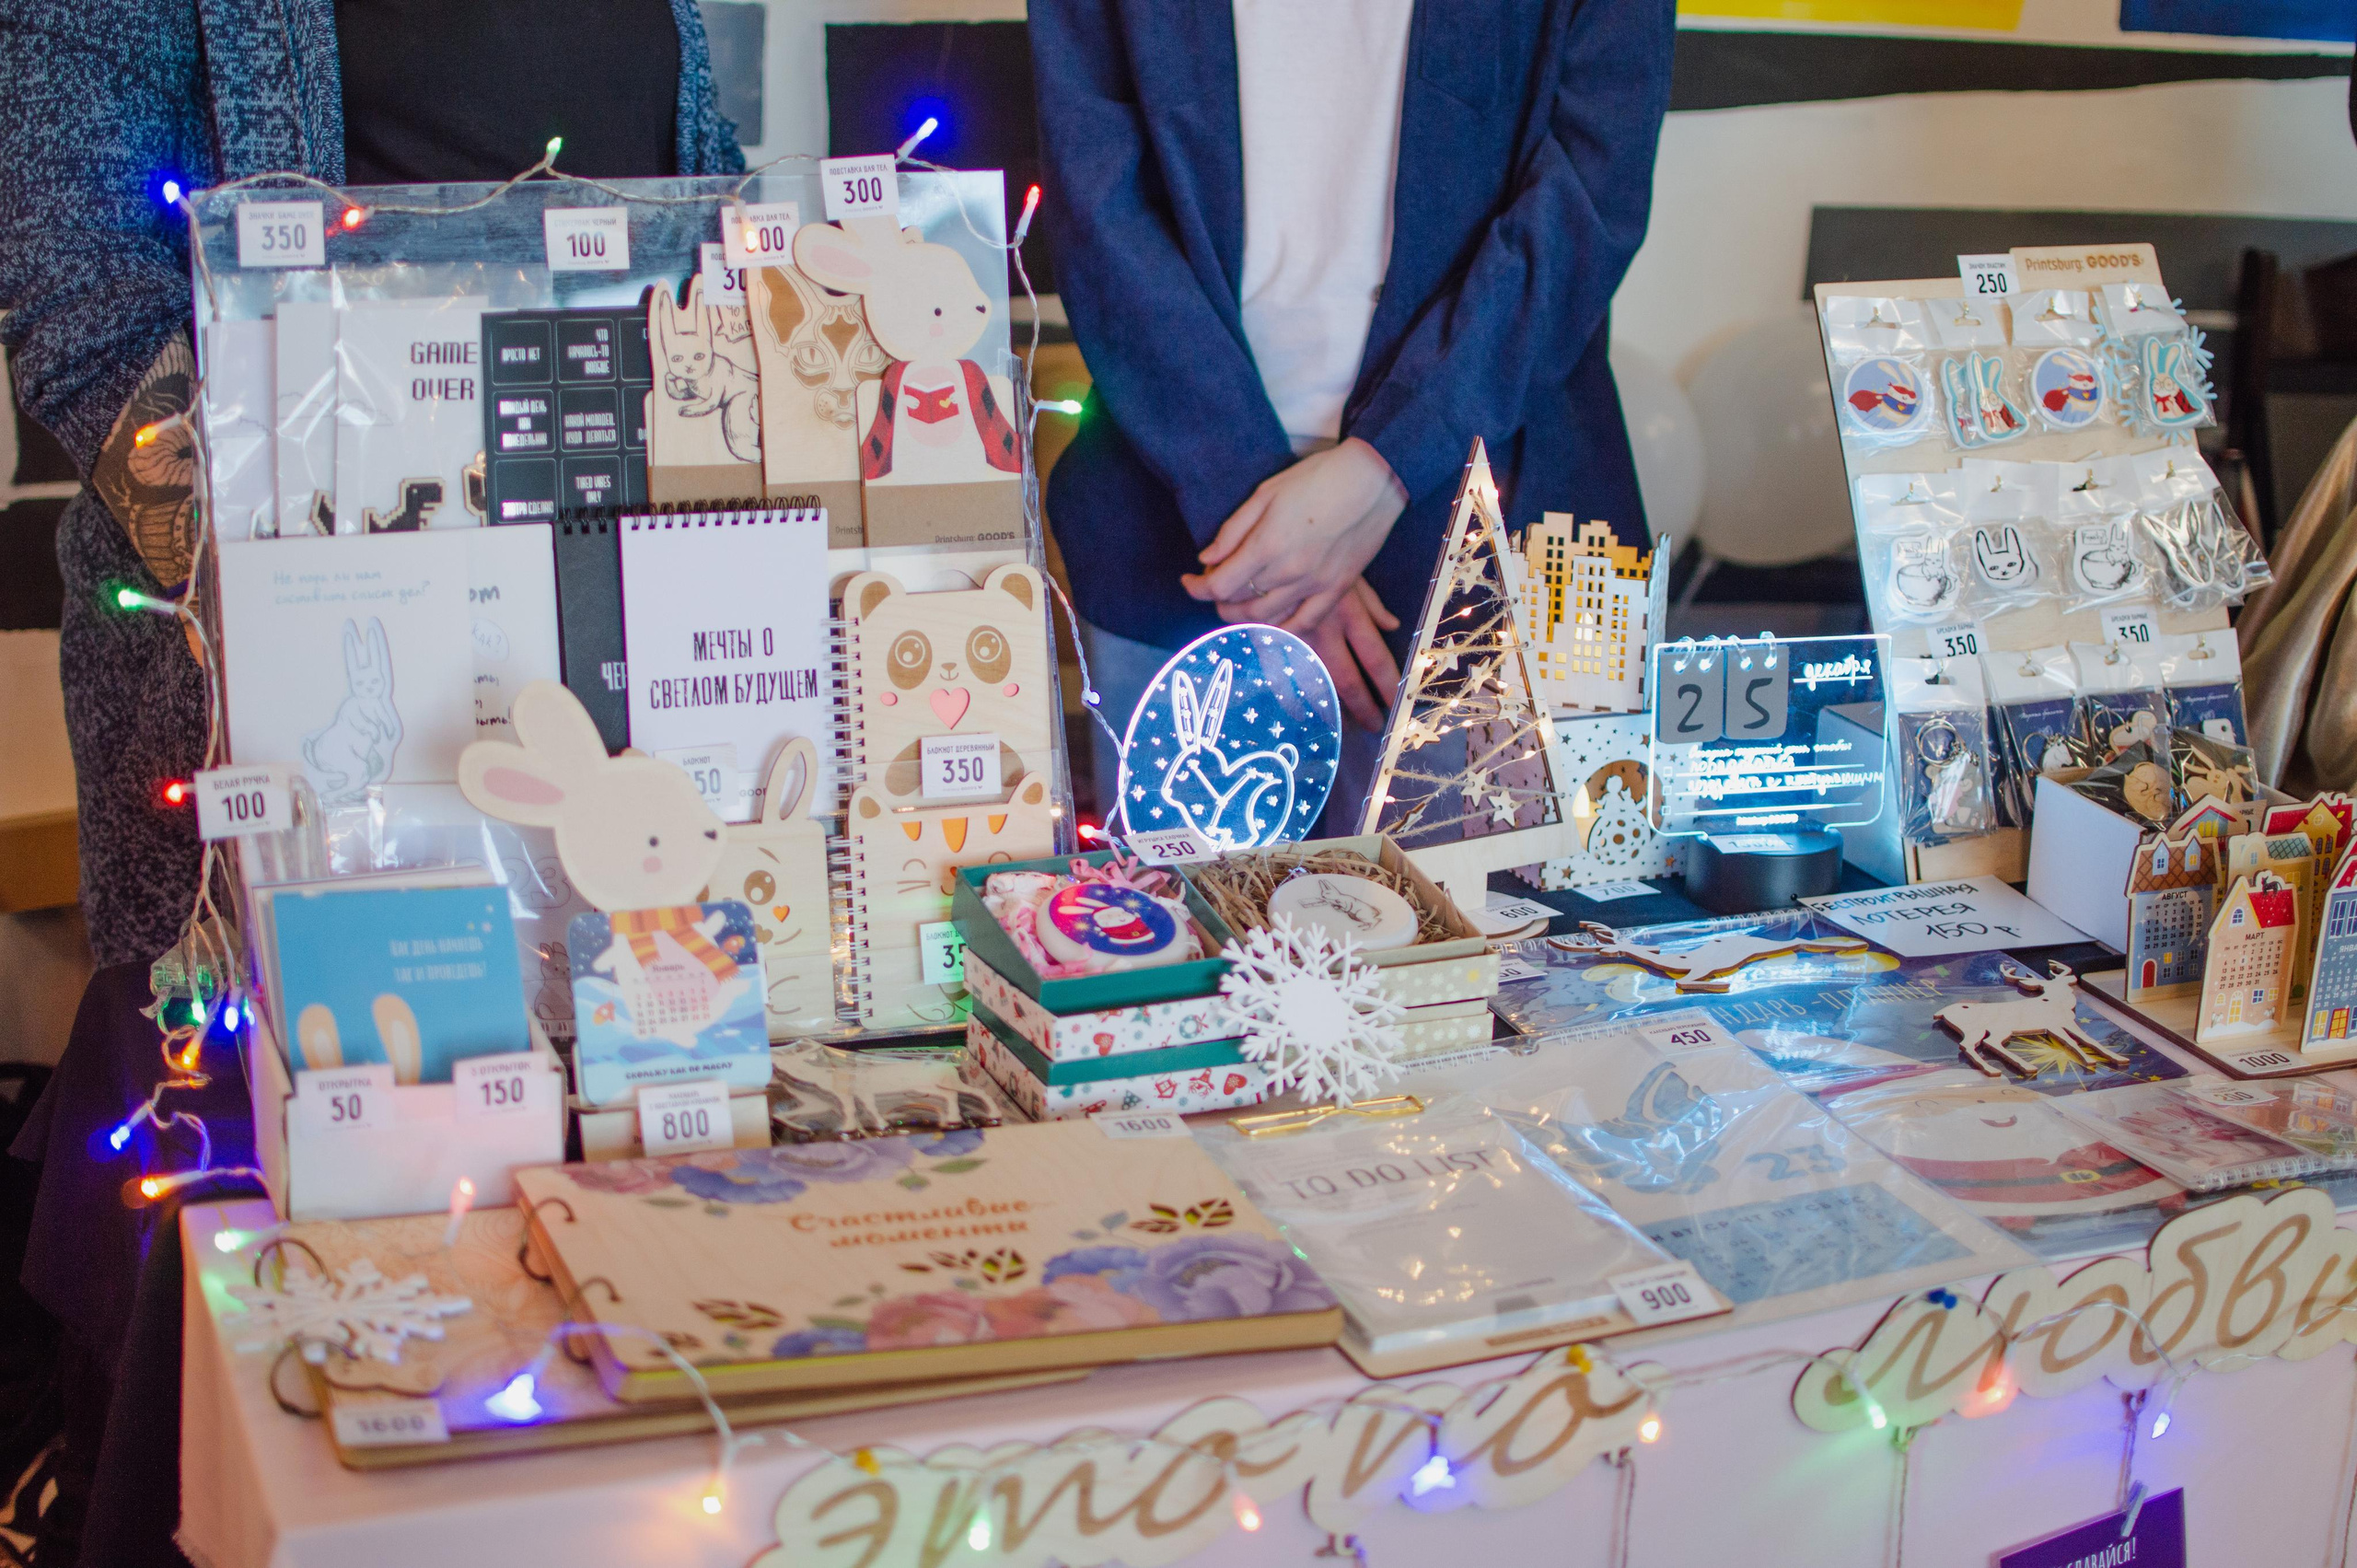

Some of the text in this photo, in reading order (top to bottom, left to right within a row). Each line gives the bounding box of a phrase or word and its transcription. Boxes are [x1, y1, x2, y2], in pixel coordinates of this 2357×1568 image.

[830, 166, 862, 175] ПОДСТАВКА
[842, 177, 883, 204] 300
[249, 212, 274, 220] ЗНАЧКИ
[592, 217, 617, 226] ЧЕРНЫЙ
[731, 214, 765, 224] ПОДАВКА
[766, 214, 778, 222] ДЛЯ
[261, 224, 307, 250] 350
[566, 231, 606, 258] 100
[745, 226, 784, 253] 00
[2026, 257, 2084, 273] Printsburg:
[1977, 273, 2007, 294] 250
[596, 329, 609, 342] ЧТО
[411, 342, 478, 365] GAME
[502, 347, 540, 362] ПРОСТО НЕТ
[412, 377, 474, 401] OVER
[530, 399, 547, 413] ДЕНЬ
[517, 417, 531, 431] КАК
[564, 412, 585, 427] КАКОЙ
[565, 428, 616, 444] КУДА ДЕВАТЬСЯ
[575, 475, 611, 490] TIRED VIBES
[586, 491, 601, 504] ONLY
[528, 500, 553, 515] СДЕЛАЮ
[2119, 623, 2149, 643] 350
[692, 627, 773, 662] МЕЧТЫ О
[1945, 633, 1978, 657] 350
[1804, 654, 1872, 691] декабря
[650, 668, 819, 710] СВЕТЛОМ БУДУЩЕМ
[1677, 683, 1703, 733] 2
[927, 742, 995, 754] БЛОКНОТ ДЕРЕВЯННЫЙ
[683, 756, 711, 766] БЛОКНОТ
[942, 757, 983, 784] 350
[214, 774, 271, 791] БЕЛАЯ РУЧКА
[222, 791, 265, 822] 100
[1152, 841, 1196, 858] 250
[1597, 885, 1638, 896] 700
[1811, 883, 1980, 912] БЕСПРОИГРЫШНАЯ
[2162, 891, 2188, 901] АВГУСТ
[1500, 906, 1538, 919] 600
[1850, 901, 1977, 926] ЛОТЕРЕЯ
[926, 931, 953, 940] БЛОКНОТ
[1926, 921, 1989, 940] 150
[2246, 932, 2265, 940] МАРТ
[1671, 1028, 1712, 1045] 450
[2238, 1052, 2291, 1067] 1000
[480, 1062, 531, 1076] ОТКРЫТОК
[625, 1068, 668, 1079] СКОЛЬЖУ
[702, 1062, 733, 1071] МАСЛУ
[319, 1078, 372, 1091] ОТКРЫТКА
[480, 1076, 525, 1105] 150
[331, 1093, 362, 1121] 50
[663, 1109, 710, 1140] 800
[1114, 1118, 1172, 1132] 1600
[1282, 1149, 1494, 1200] TO DO LIST
[1641, 1283, 1691, 1309] 900
